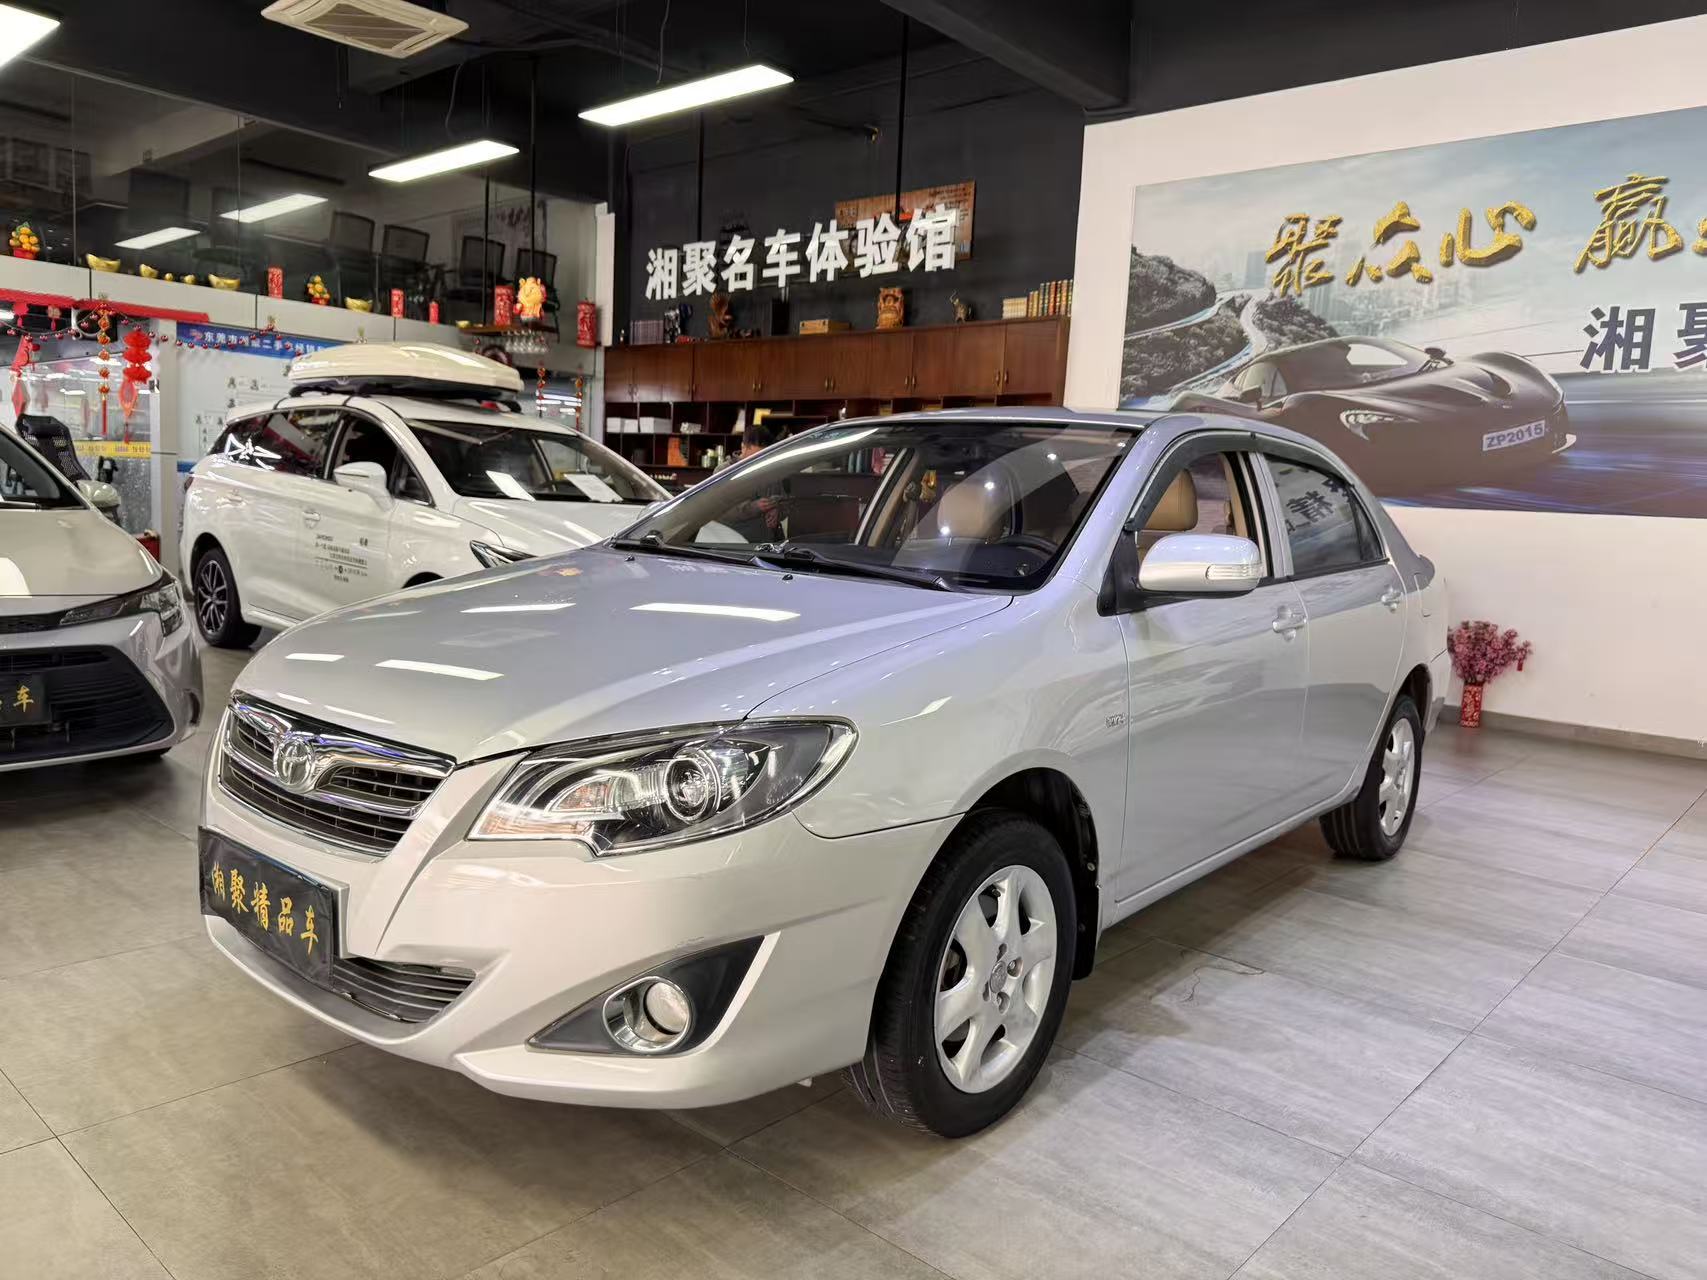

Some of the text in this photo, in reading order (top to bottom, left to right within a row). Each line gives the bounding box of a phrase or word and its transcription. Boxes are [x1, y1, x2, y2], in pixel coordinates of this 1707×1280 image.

[645, 204, 958, 301] 湘聚名车体验馆
[1573, 173, 1707, 273] 赢
[1487, 423, 1544, 448] ZP2015
[212, 861, 319, 956] 湘聚精品车
